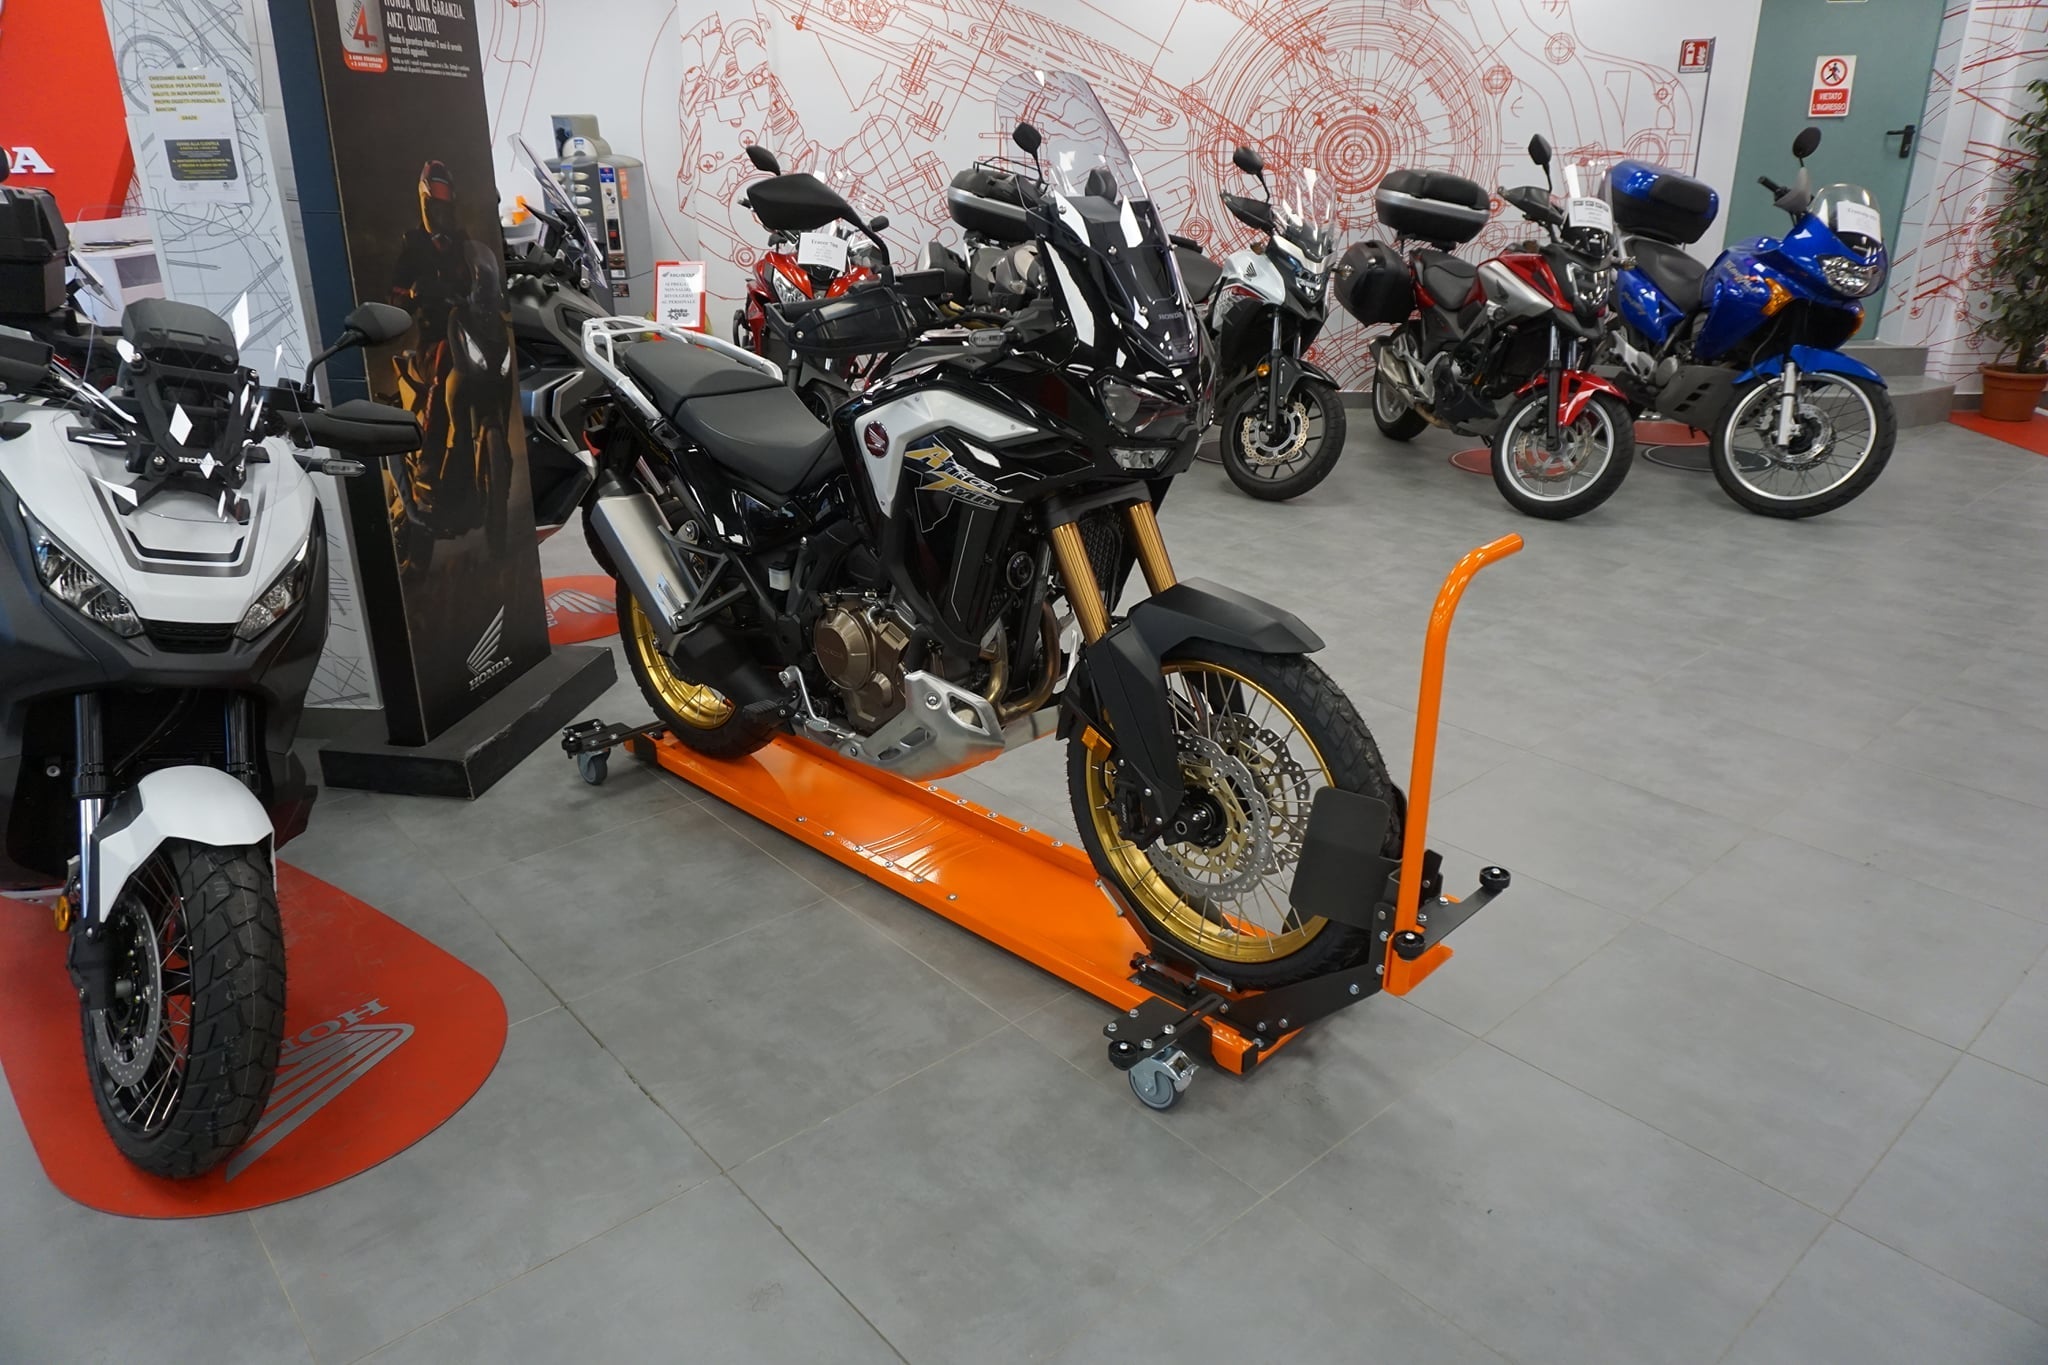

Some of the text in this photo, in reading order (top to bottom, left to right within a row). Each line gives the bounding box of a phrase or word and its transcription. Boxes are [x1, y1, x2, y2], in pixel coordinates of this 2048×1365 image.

[415, 0, 431, 13] UNA
[352, 4, 378, 48] 4
[386, 11, 440, 35] ANZI, QUATTRO.
[1819, 92, 1843, 100] VIETATO
[177, 456, 224, 467] HONA
[469, 656, 513, 692] HONDA
